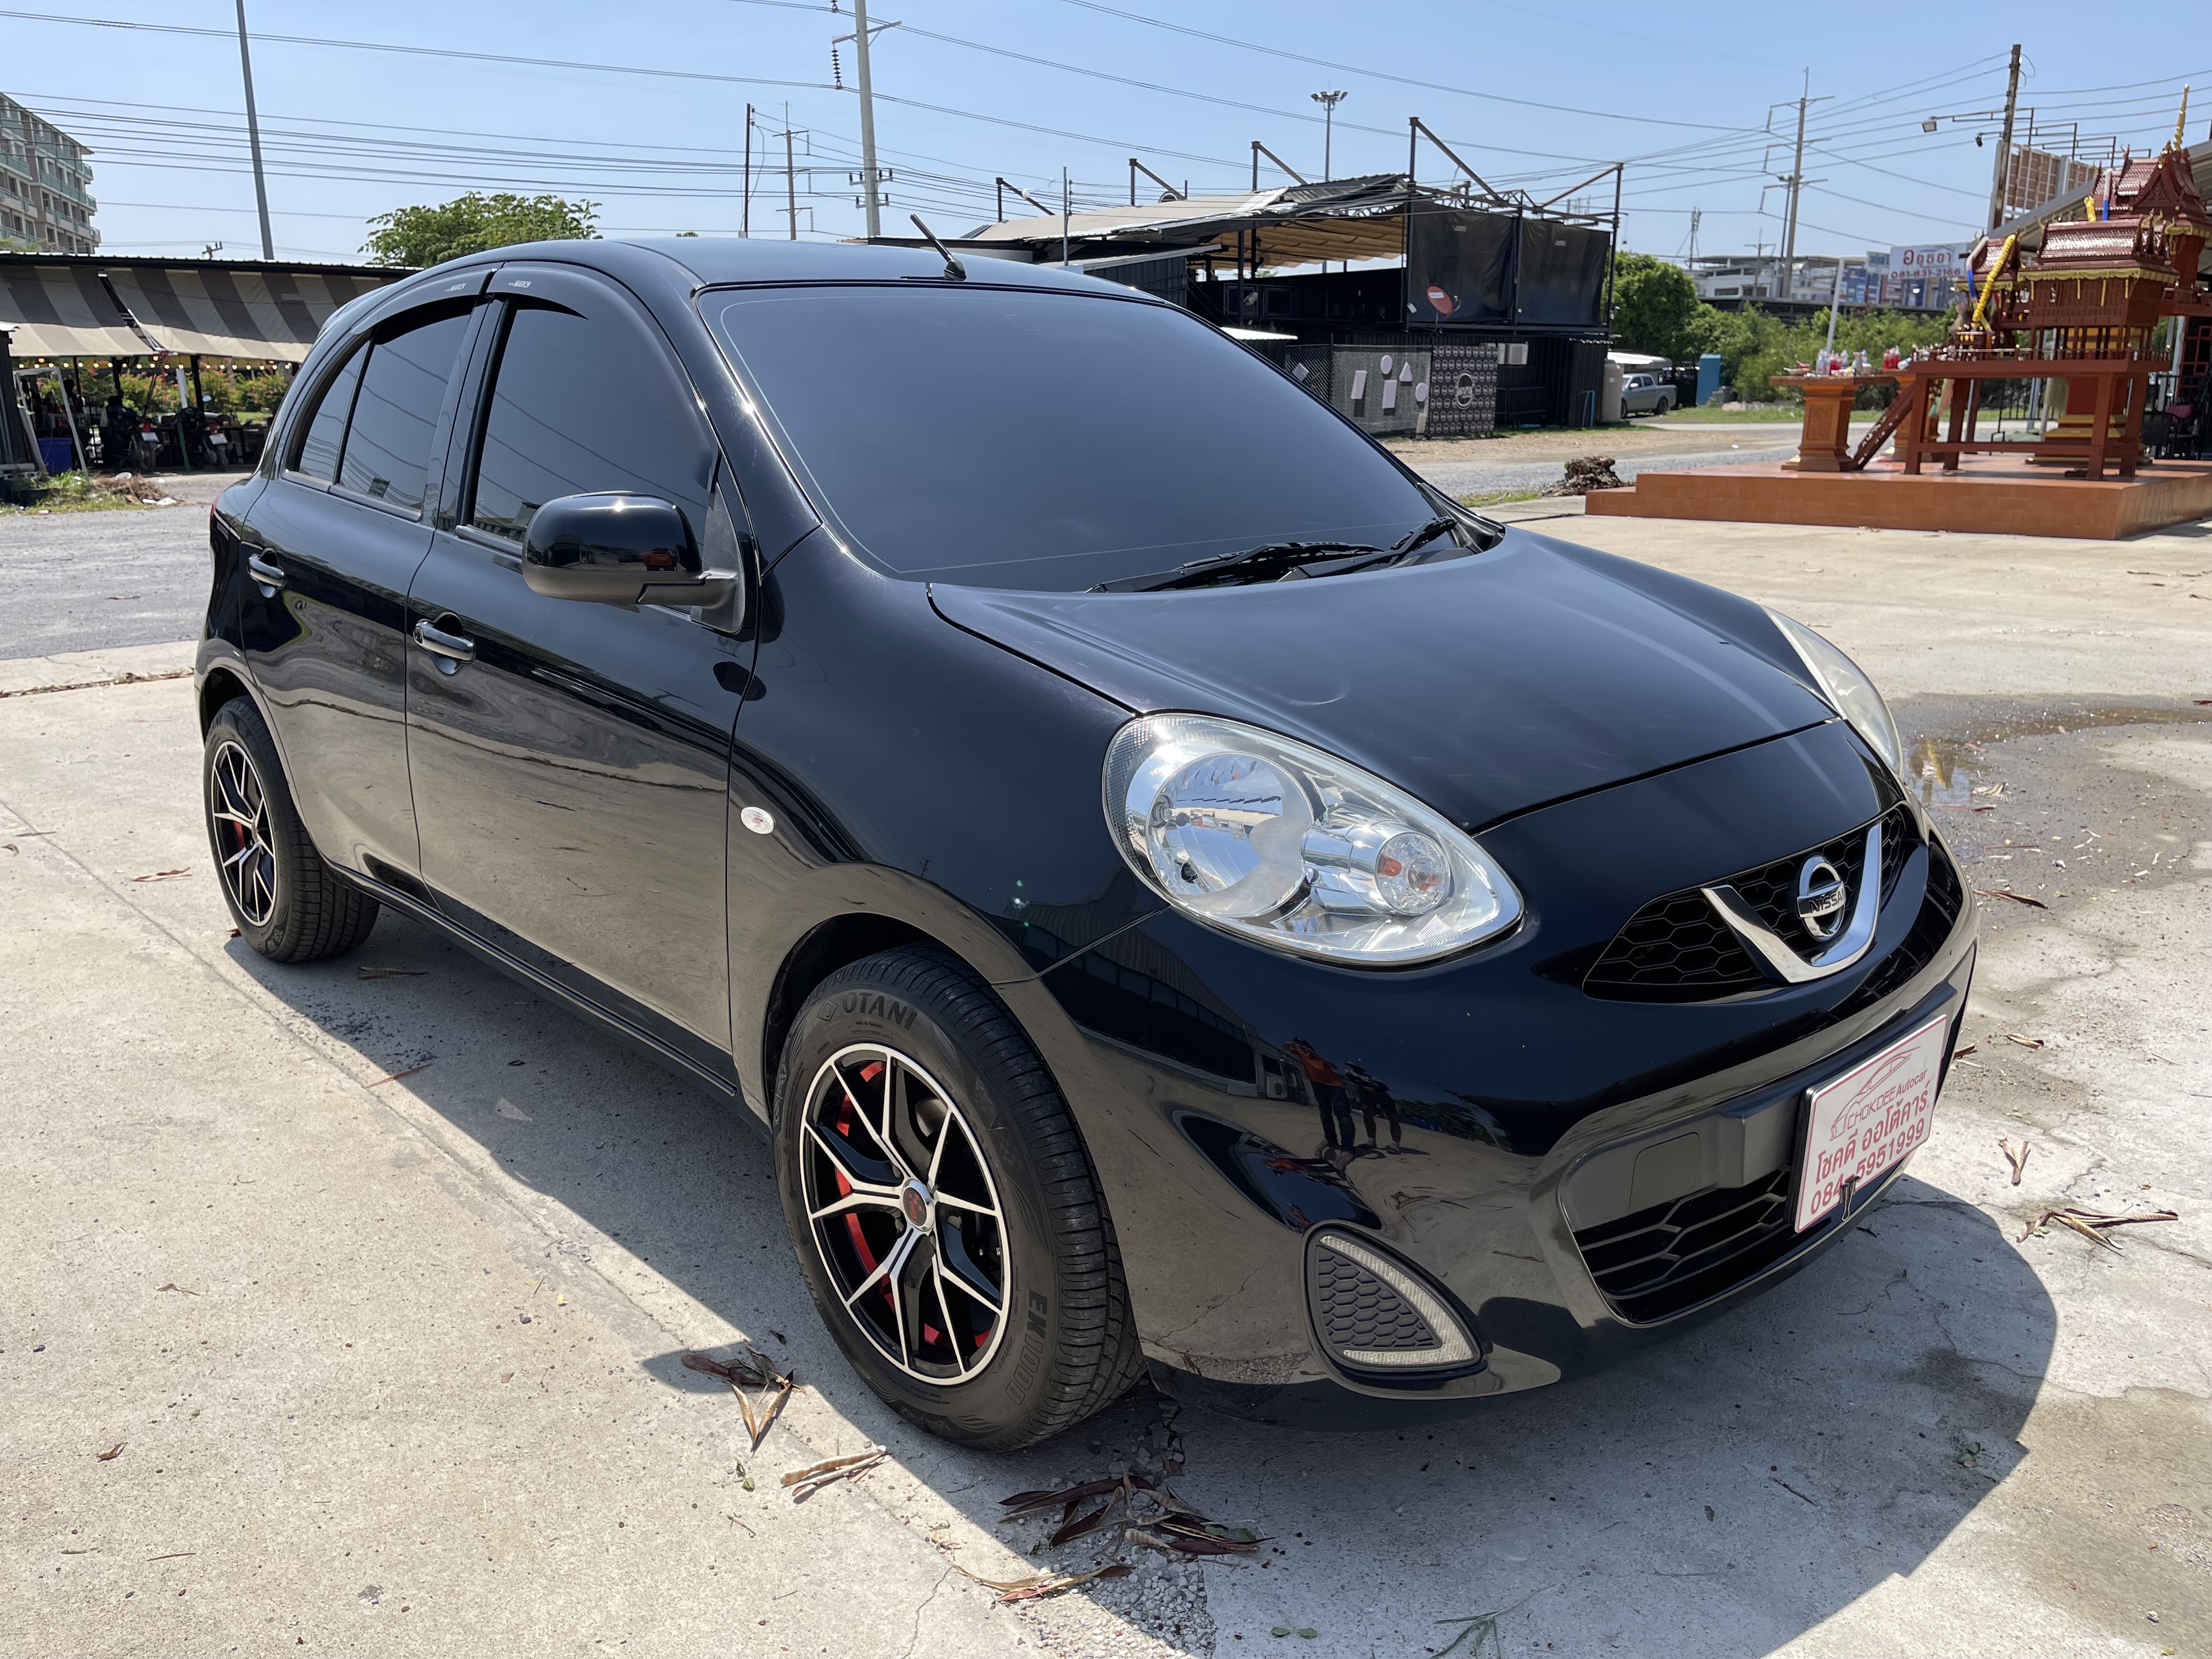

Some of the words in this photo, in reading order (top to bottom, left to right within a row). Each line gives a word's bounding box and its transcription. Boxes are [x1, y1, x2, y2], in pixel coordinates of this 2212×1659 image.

[842, 992, 917, 1031] OTANI
[1895, 1069, 1927, 1099] Autocar
[1816, 1128, 1858, 1184] โชคดี
